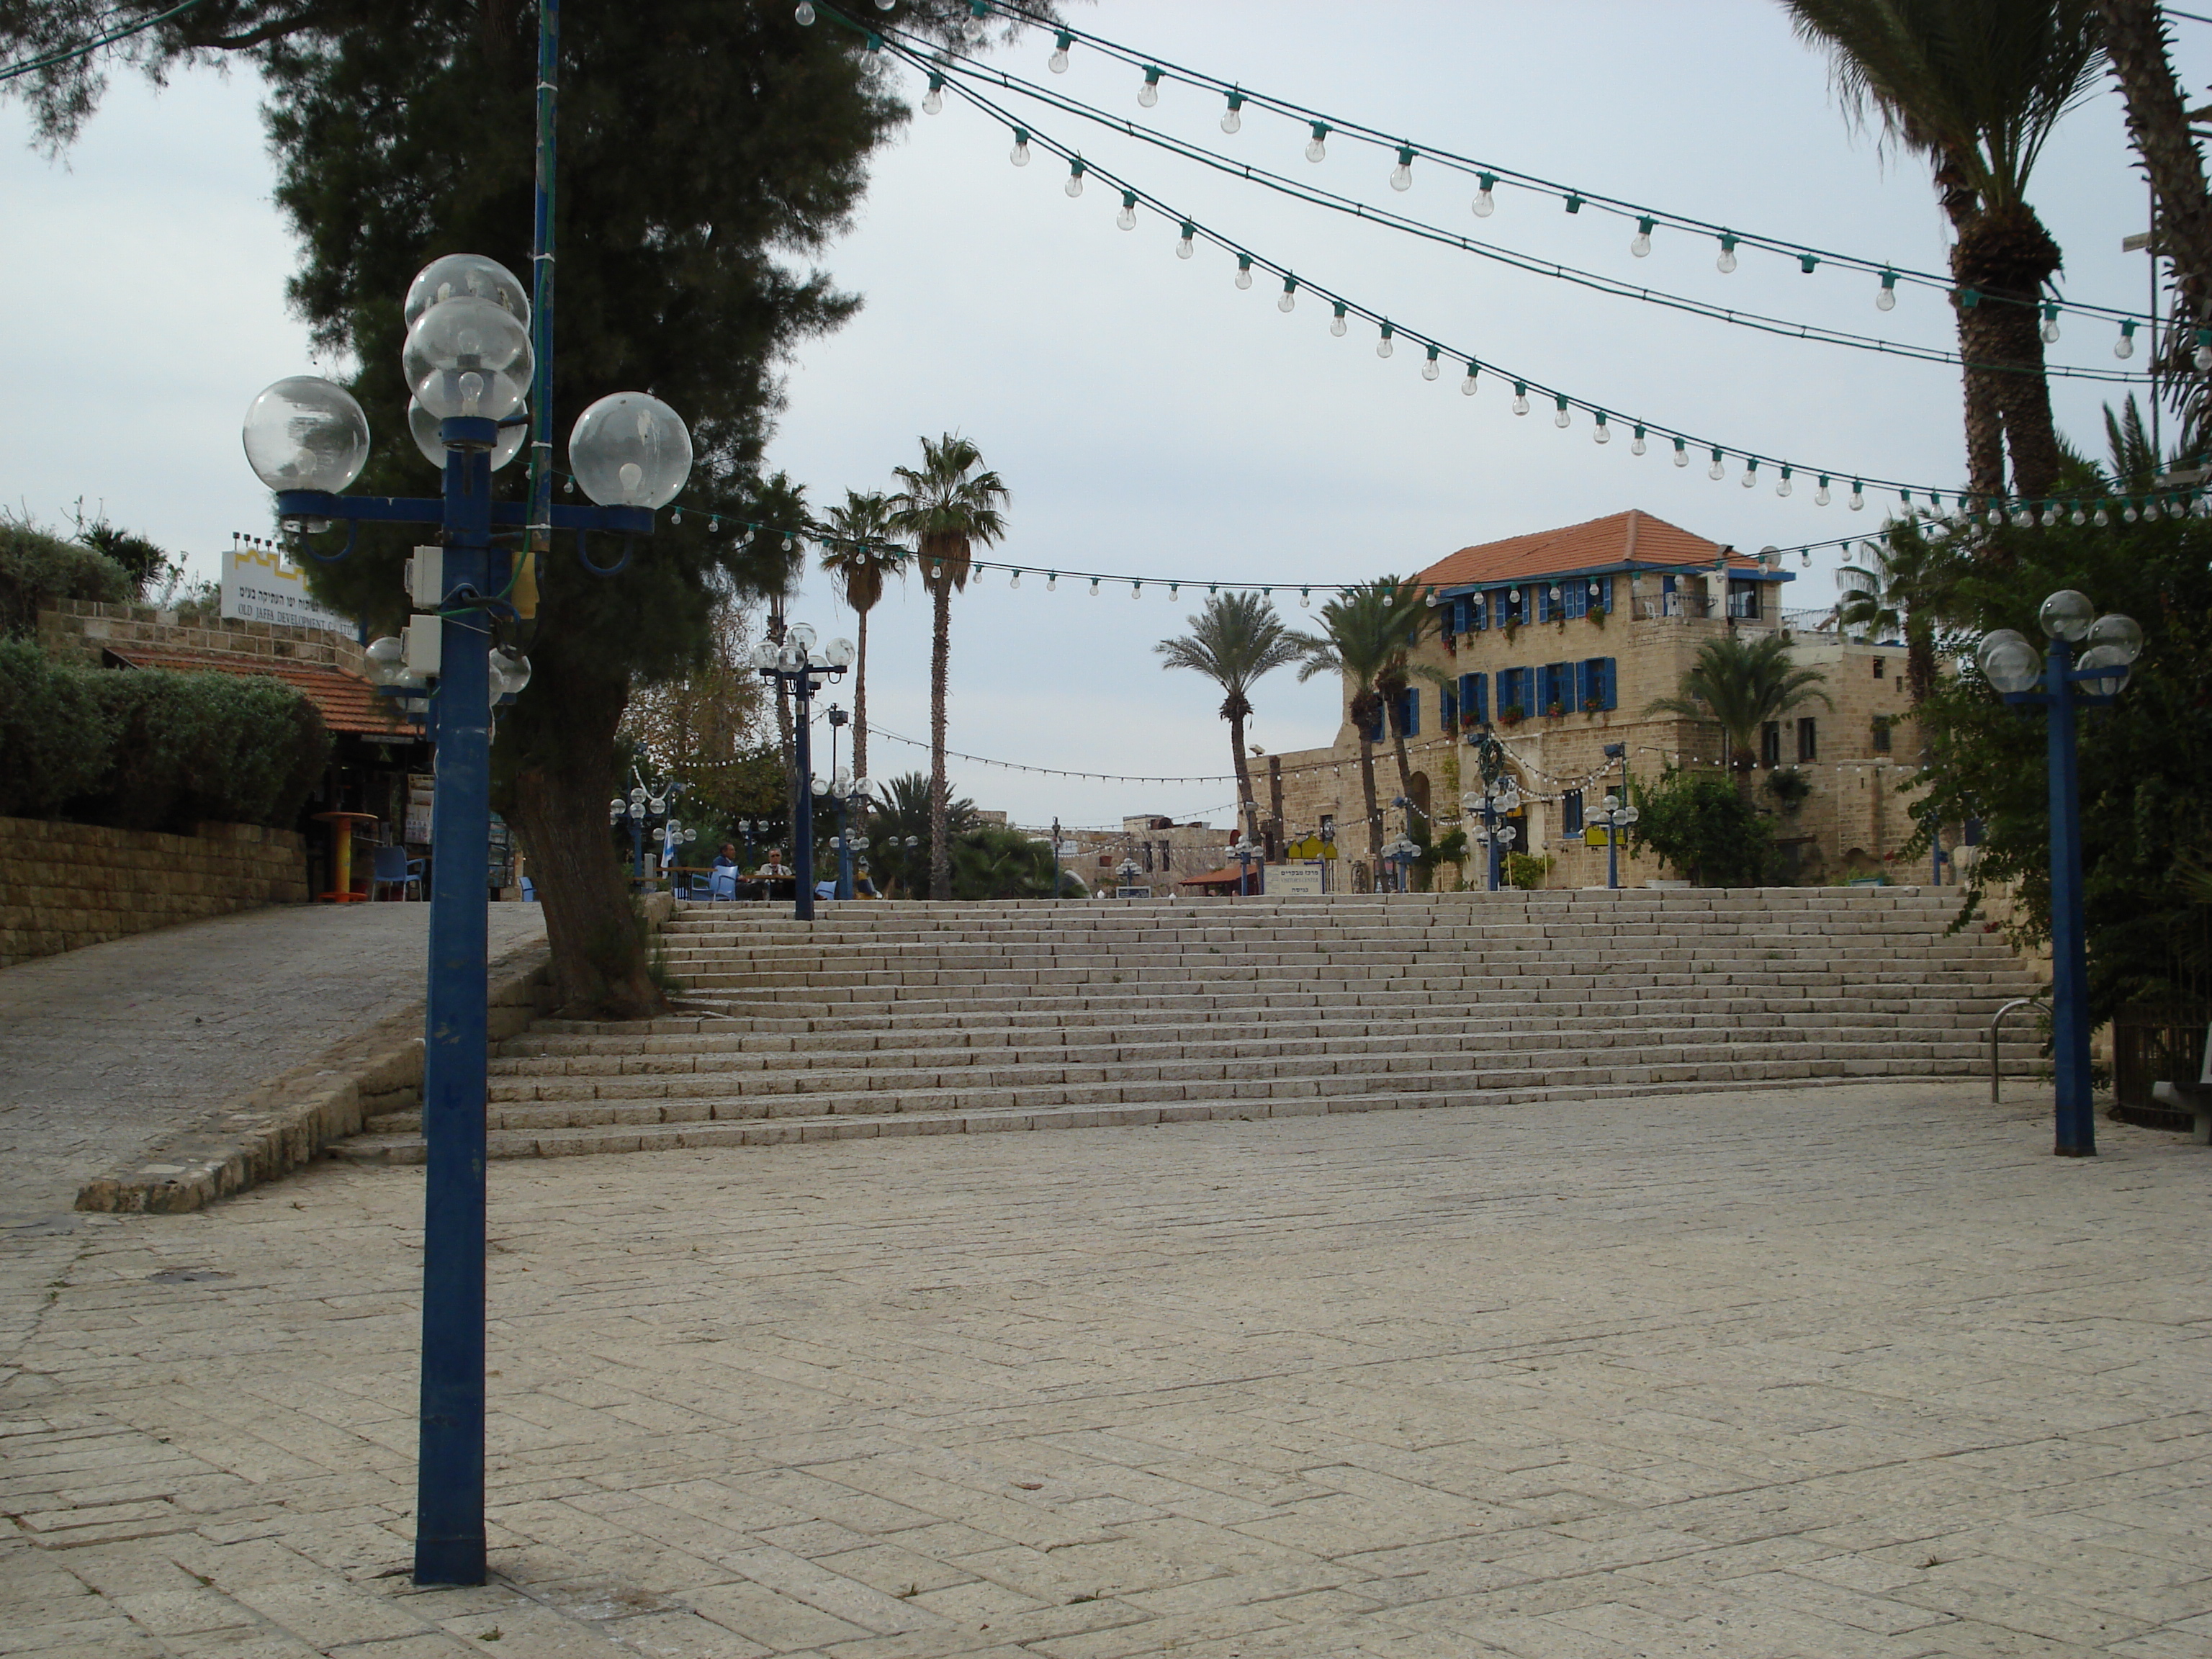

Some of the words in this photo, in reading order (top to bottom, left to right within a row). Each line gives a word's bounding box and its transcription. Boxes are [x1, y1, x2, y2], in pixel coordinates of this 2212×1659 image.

[258, 590, 284, 605] העתיקה
[238, 603, 253, 616] OLD
[255, 607, 274, 621] JAFFA
[277, 611, 325, 629] DEVELOPMENT
